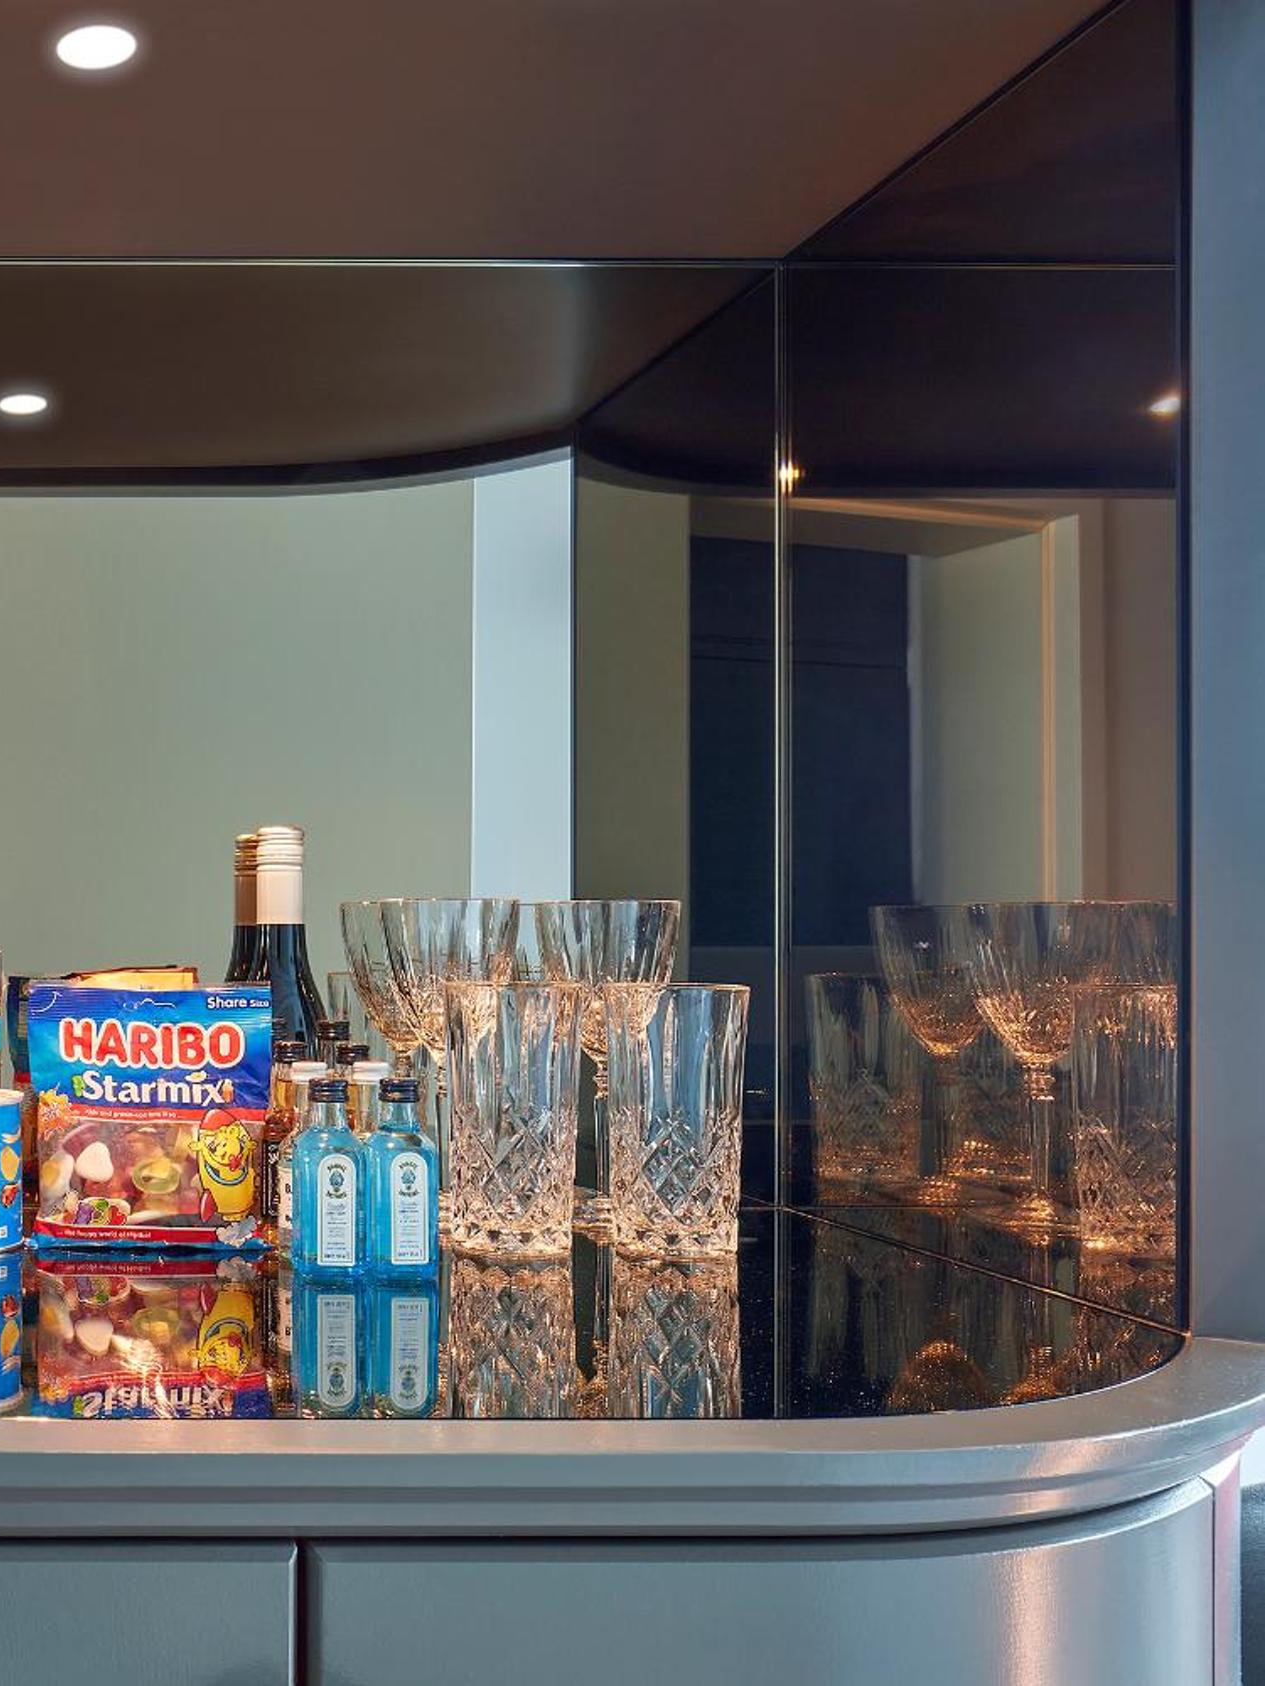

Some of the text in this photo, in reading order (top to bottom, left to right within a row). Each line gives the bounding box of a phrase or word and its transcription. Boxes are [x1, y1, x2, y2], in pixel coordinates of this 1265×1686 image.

[207, 996, 248, 1009] Share
[59, 1018, 245, 1069] HARIBO
[82, 1070, 228, 1107] Starmix
